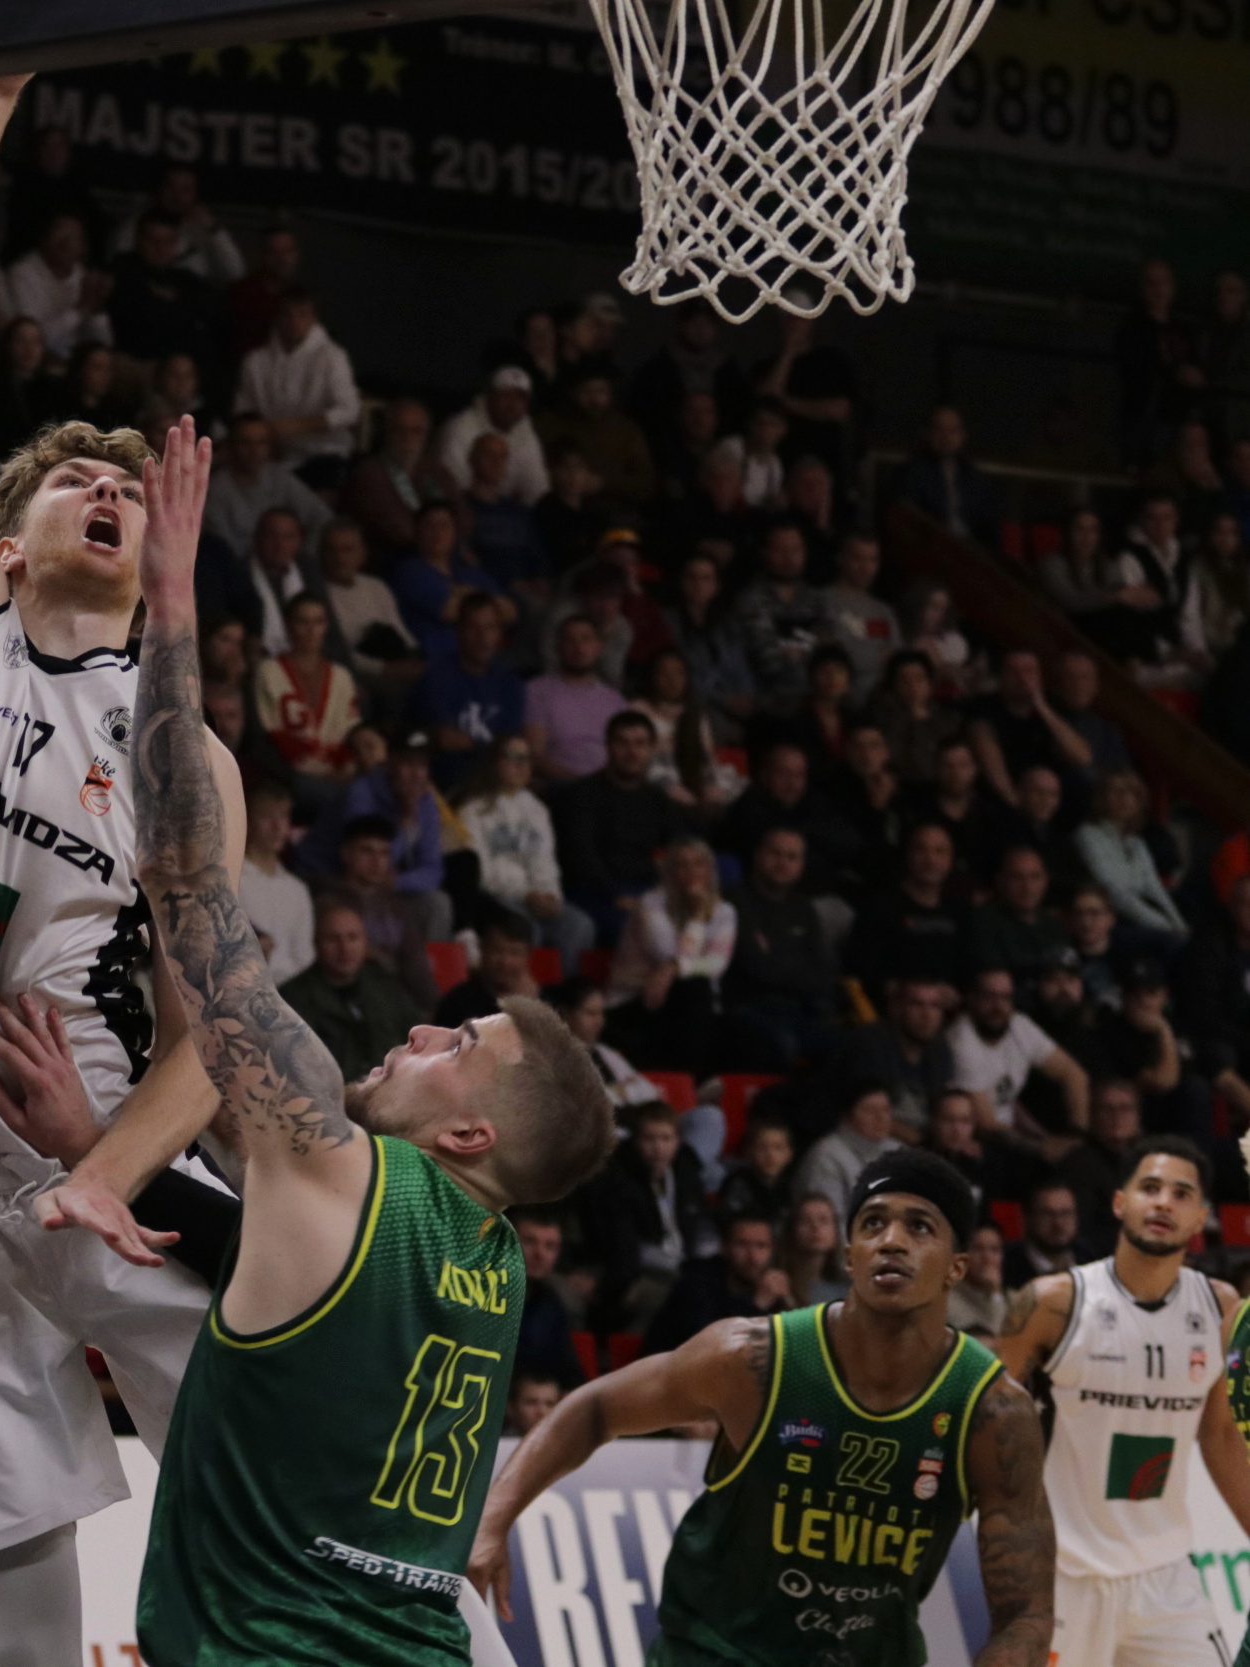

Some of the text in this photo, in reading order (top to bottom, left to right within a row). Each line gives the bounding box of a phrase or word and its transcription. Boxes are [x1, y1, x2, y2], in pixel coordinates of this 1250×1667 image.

[916, 50, 1178, 158] 988/89
[33, 82, 645, 214] MAJSTER SR 2015/20
[12, 712, 56, 777] 17
[1146, 1344, 1165, 1380] 11
[369, 1333, 500, 1526] 13
[836, 1431, 901, 1495] 22
[772, 1502, 934, 1575] LEVICE
